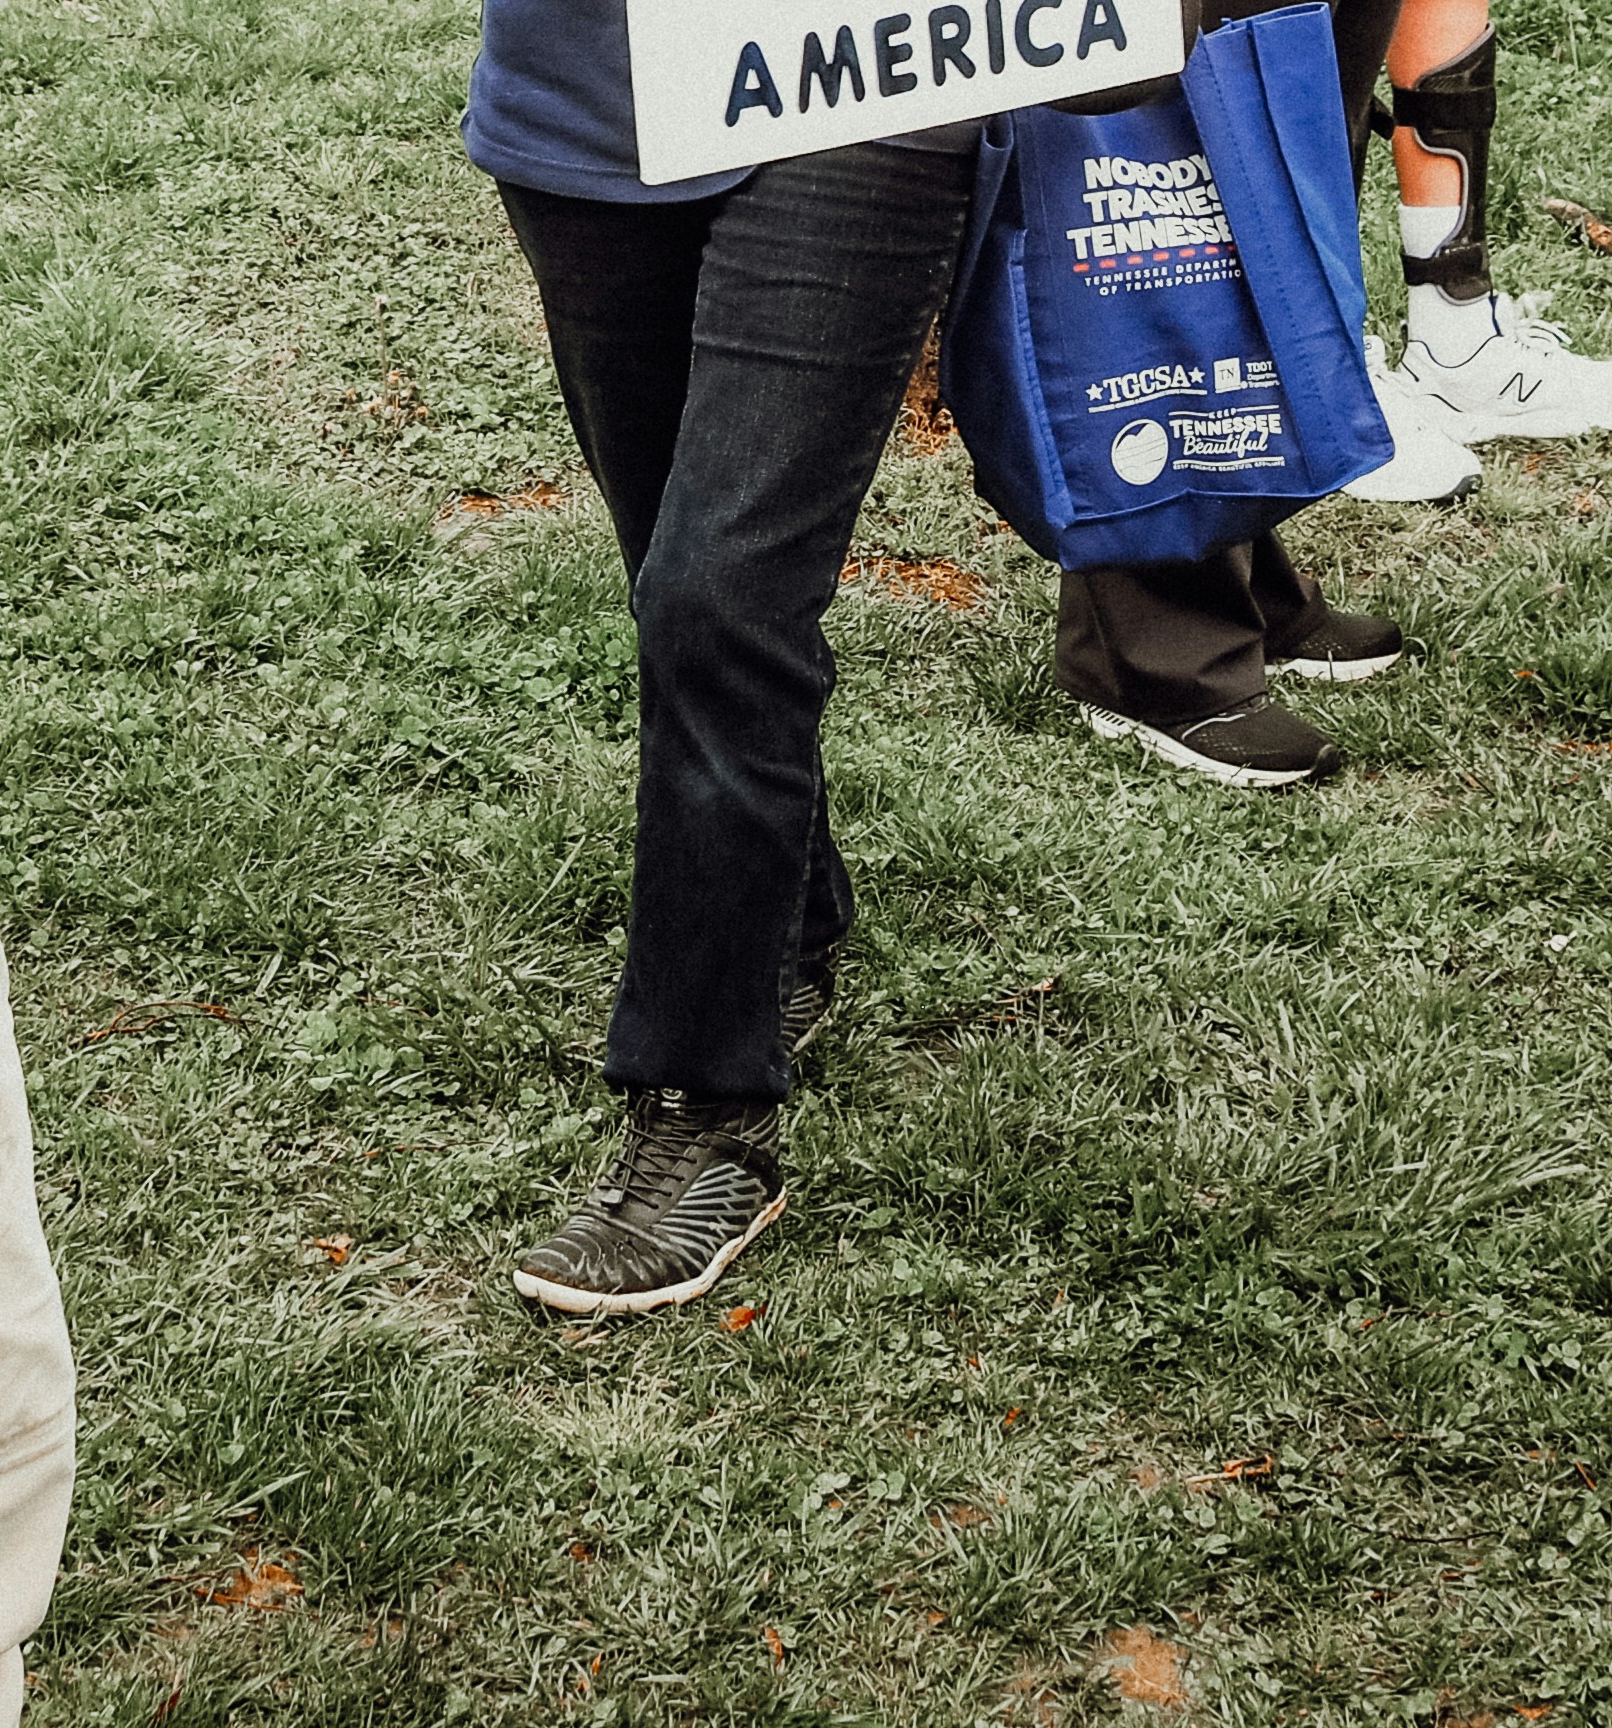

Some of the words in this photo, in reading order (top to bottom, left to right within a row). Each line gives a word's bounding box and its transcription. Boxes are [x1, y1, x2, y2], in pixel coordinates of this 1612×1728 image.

[1083, 153, 1213, 190] NOBODY
[1065, 214, 1233, 260] TENNESSE
[1084, 266, 1168, 287] TENNESSEE
[1175, 257, 1237, 274] DEPARTM
[1099, 285, 1118, 296] OF
[1125, 268, 1241, 292] TRANSPORTATIO
[1219, 367, 1235, 380] TN
[1245, 360, 1273, 373] TDOT
[1102, 364, 1192, 403] TGCSA
[1169, 413, 1283, 439] TENNESSEE
[1208, 407, 1237, 419] KEEP
[1183, 431, 1268, 459] Beautiful
